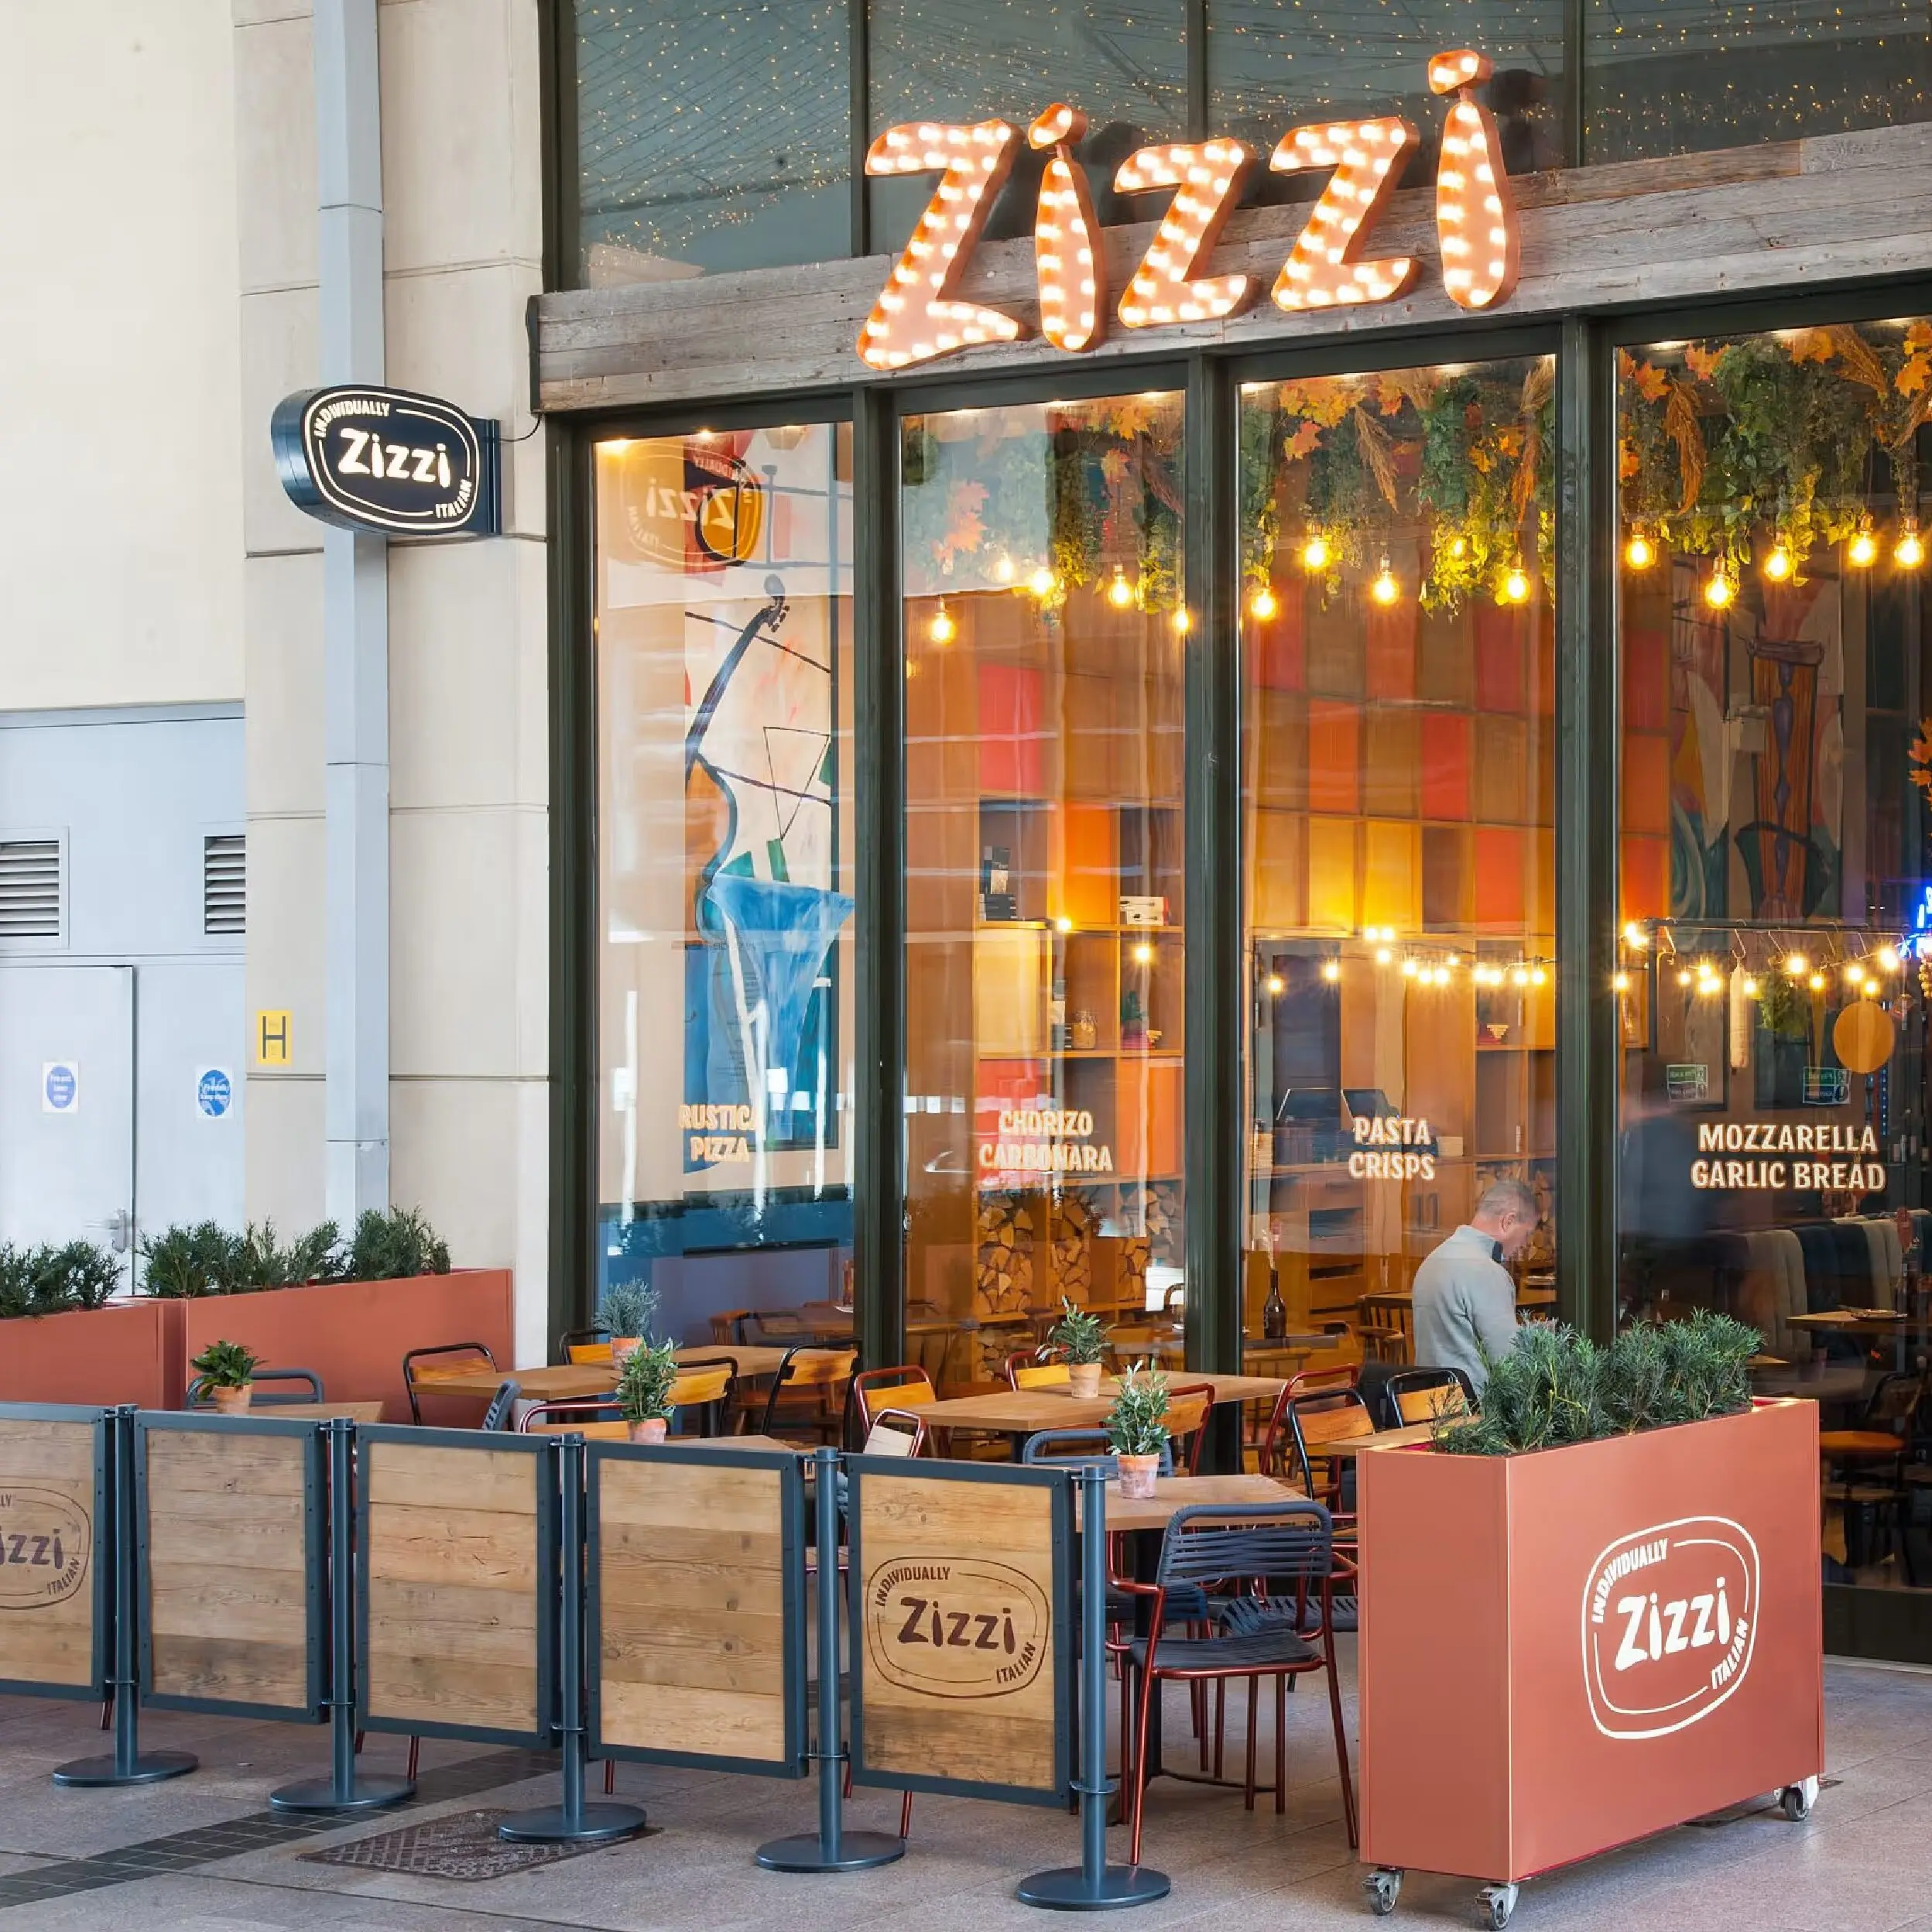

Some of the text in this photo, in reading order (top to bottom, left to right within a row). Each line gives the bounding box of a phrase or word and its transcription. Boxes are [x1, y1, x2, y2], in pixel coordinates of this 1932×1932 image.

[856, 49, 1519, 371] Zizzi
[313, 399, 390, 438] INDIVIDUALLY
[337, 427, 451, 489] Zizzi
[435, 478, 472, 519] ITALIAN
[262, 1016, 286, 1060] H
[999, 1110, 1094, 1136] CHORIZO
[1353, 1116, 1432, 1145] PASTA
[1698, 1123, 1879, 1153] MOZZARELLA
[690, 1136, 750, 1163] PIZZA
[978, 1143, 1114, 1172] CARBONARA
[1348, 1152, 1436, 1180] CRISPS
[1690, 1160, 1887, 1191] GARLIC BREAD
[46, 1557, 80, 1595] ITALIAN
[875, 1566, 951, 1607] INDIVIDUALLY
[1591, 1537, 1669, 1623] INDIVIDUALLY
[897, 1596, 1016, 1655] Zizzi
[1615, 1576, 1731, 1671] Zizzi
[995, 1641, 1036, 1684] ITALIAN
[1711, 1617, 1749, 1690] ITALIAN
